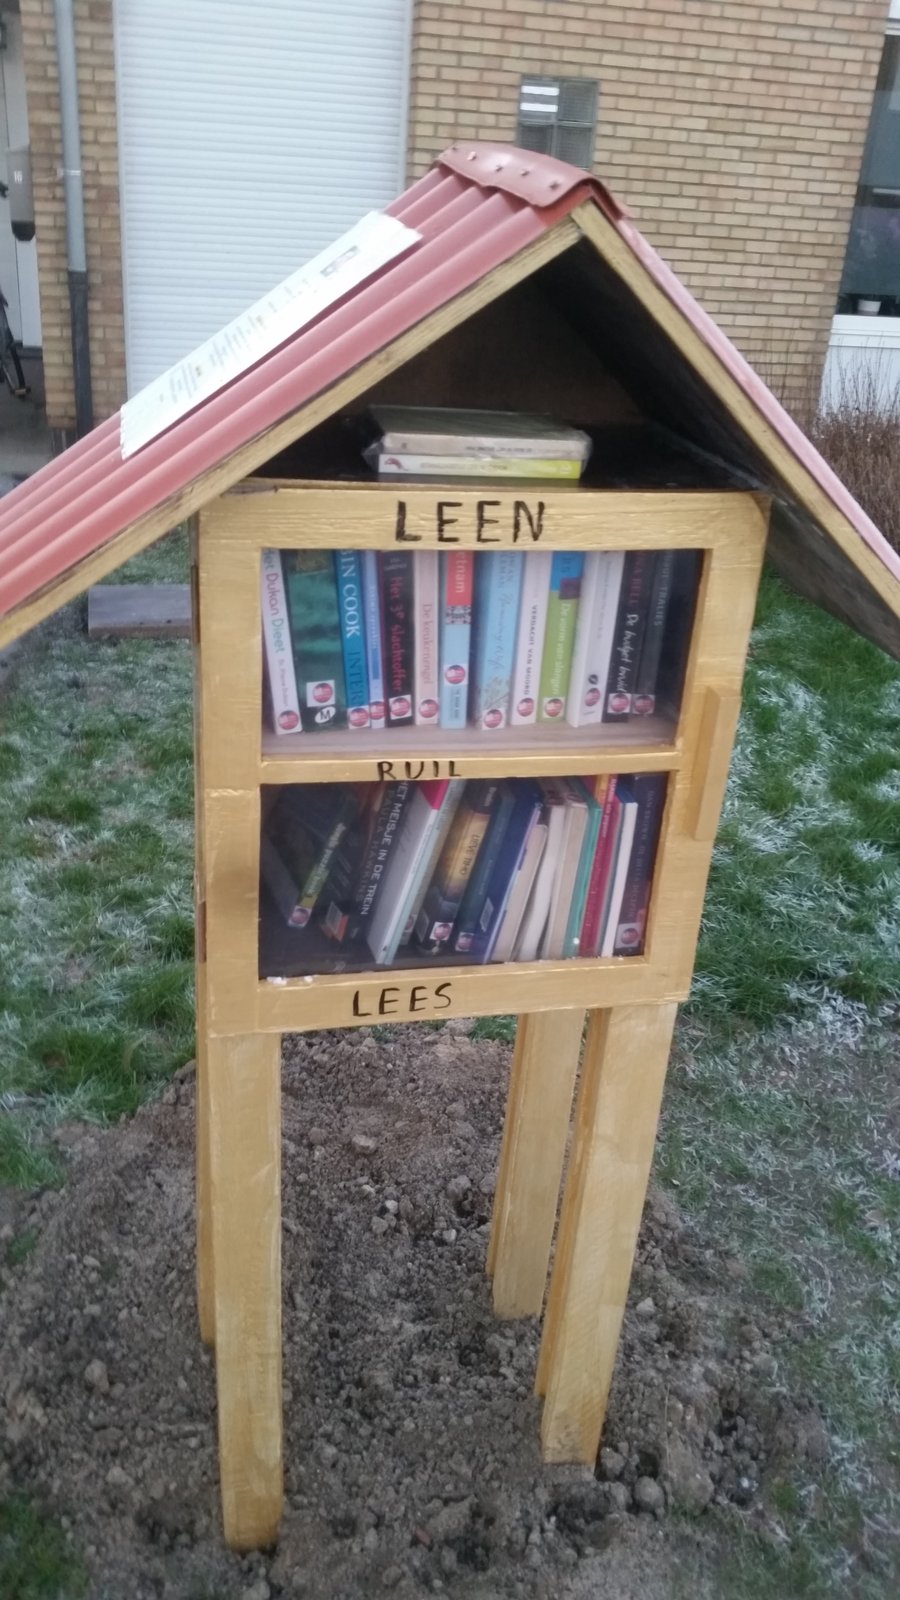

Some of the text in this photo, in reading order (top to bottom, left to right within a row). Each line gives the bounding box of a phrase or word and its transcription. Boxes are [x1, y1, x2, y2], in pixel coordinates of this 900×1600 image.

[395, 499, 545, 543] LEEN
[265, 572, 280, 617] Dukan
[390, 576, 403, 600] Het
[342, 584, 360, 639] COOK
[422, 604, 433, 619] De
[528, 604, 539, 645] VERDACHT
[625, 613, 639, 627] De
[271, 618, 285, 653] Dieet
[616, 630, 637, 662] budget
[391, 624, 407, 691] slachtoffer
[525, 648, 535, 665] VAN
[377, 760, 461, 780] RUIL
[382, 802, 402, 845] MEISJE
[356, 789, 395, 902] PAULA HAWKINS
[377, 849, 388, 860] IN
[371, 864, 383, 880] DE
[360, 883, 377, 915] TREIN
[353, 982, 452, 1017] LEES
